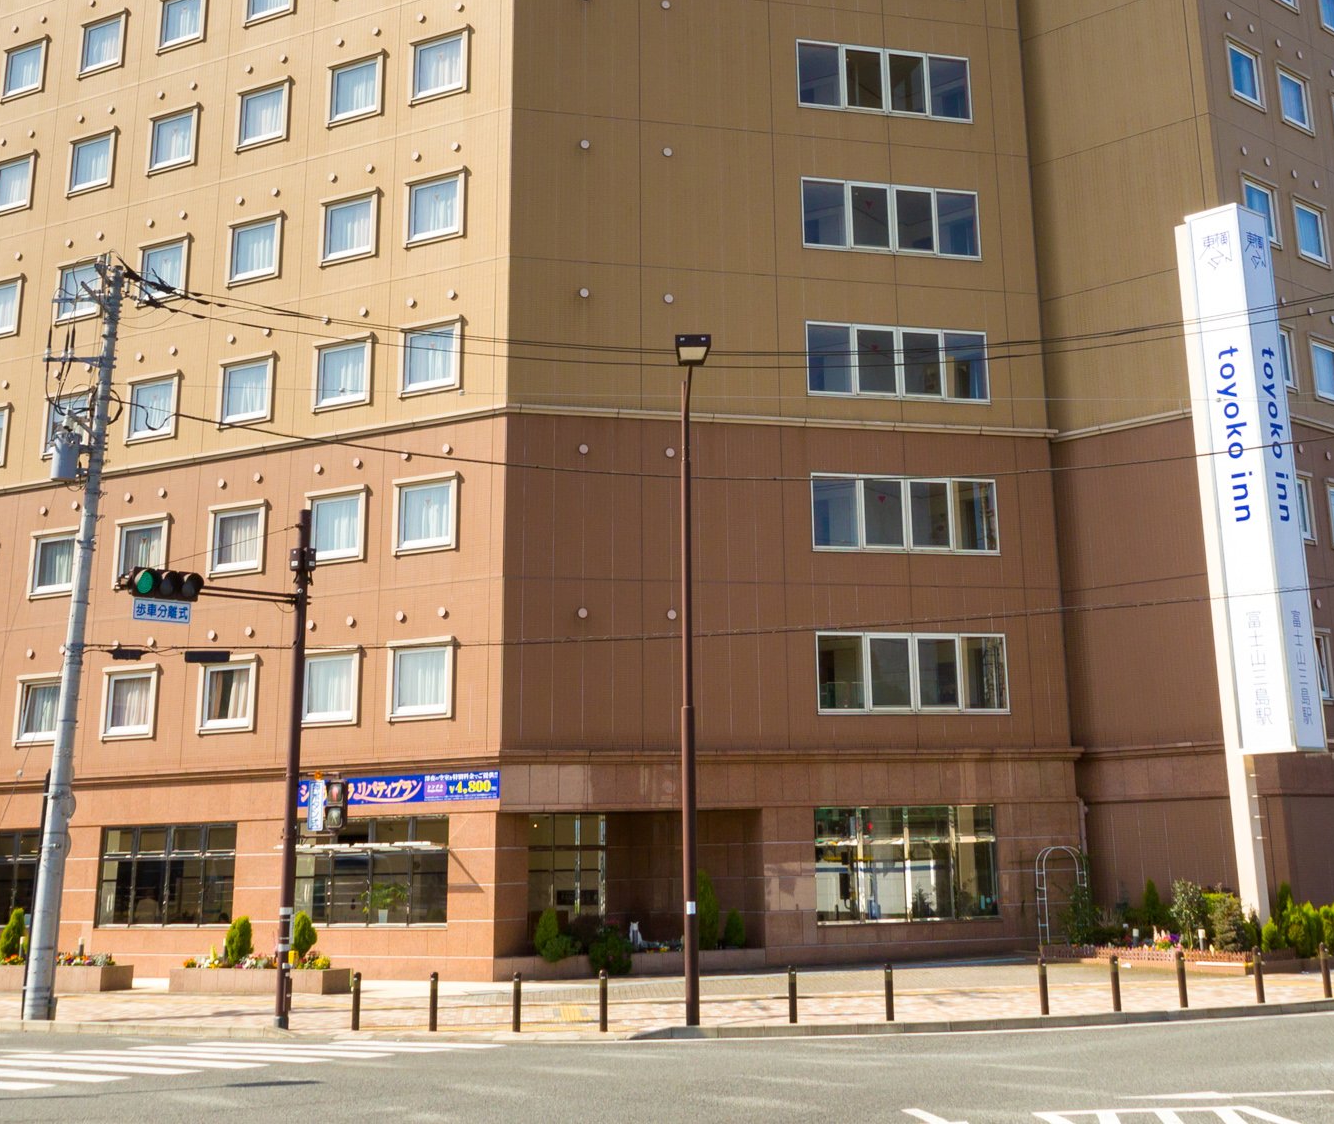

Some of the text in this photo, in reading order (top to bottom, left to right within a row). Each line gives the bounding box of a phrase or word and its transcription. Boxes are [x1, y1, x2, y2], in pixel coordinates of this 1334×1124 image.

[1216, 345, 1252, 522] toyoko inn
[1261, 346, 1290, 522] toyoko inn
[136, 603, 189, 620] 歩車分離式
